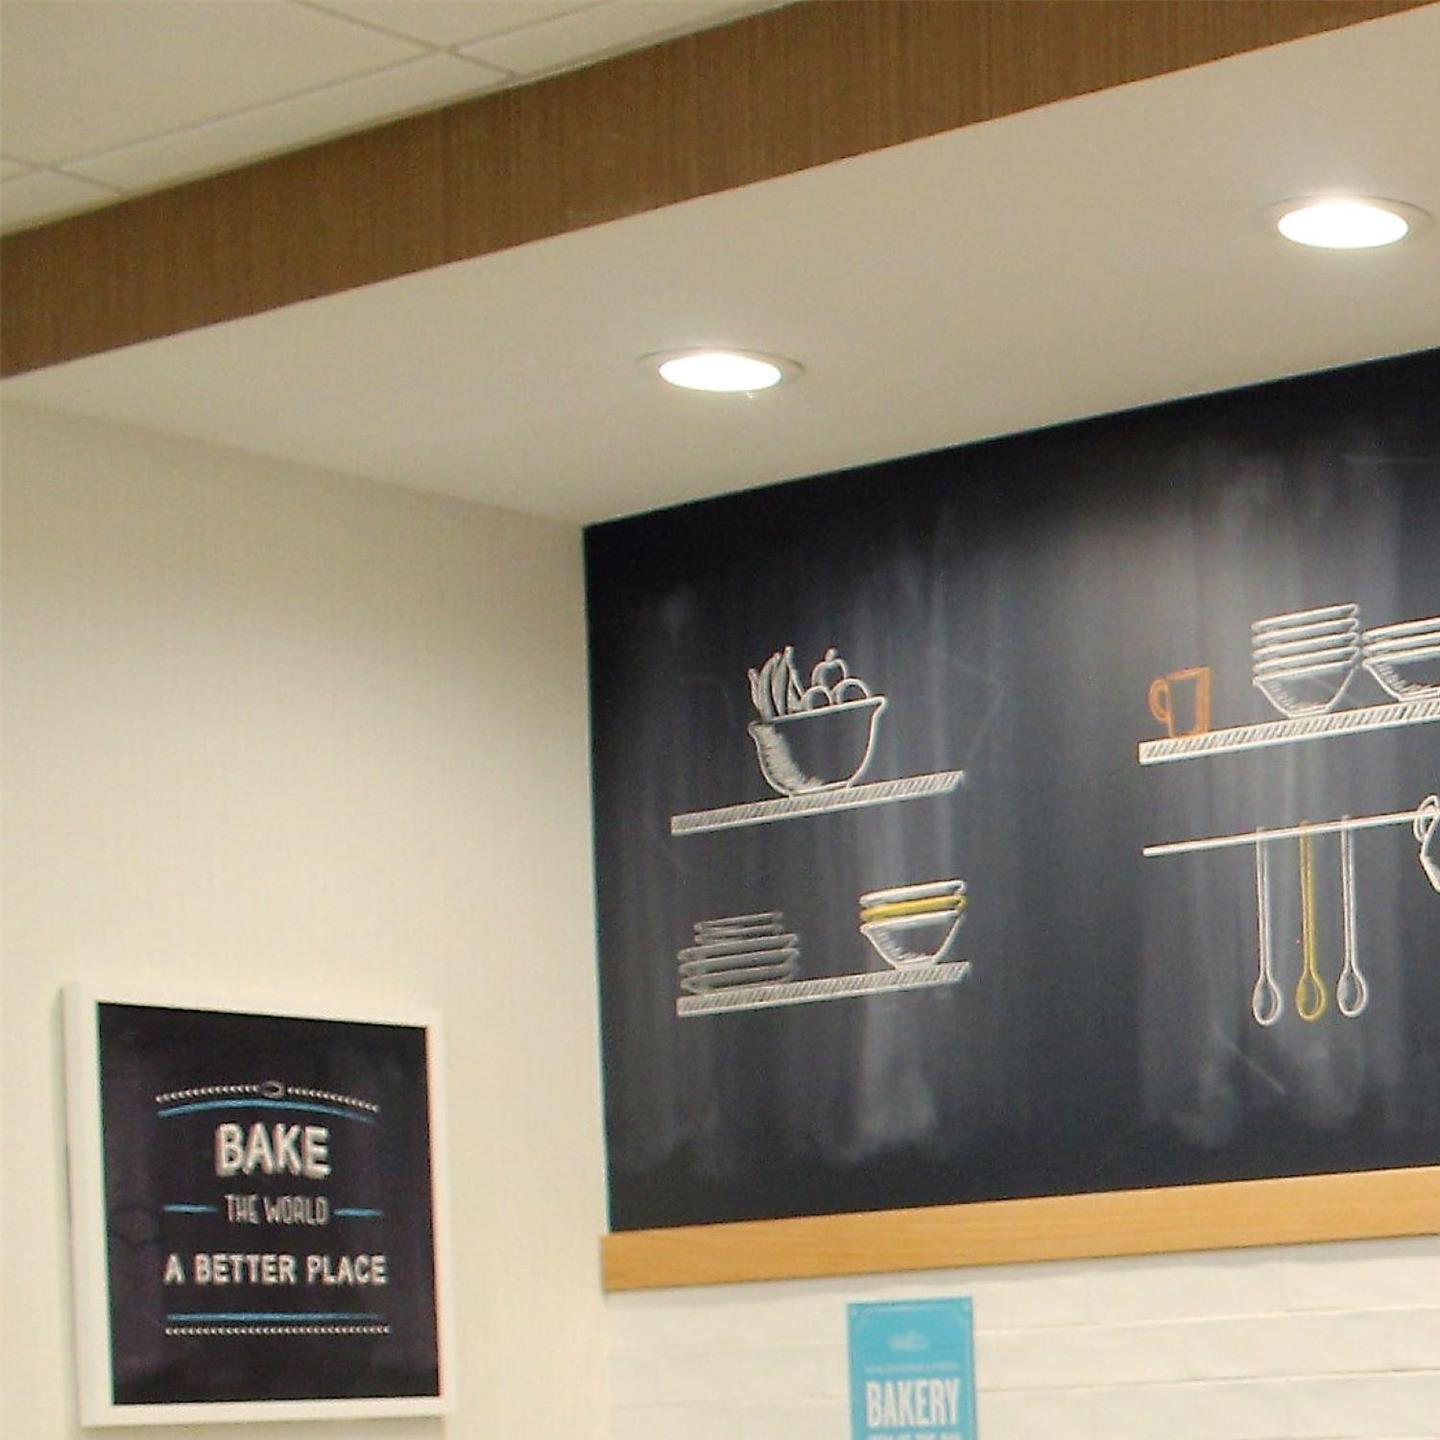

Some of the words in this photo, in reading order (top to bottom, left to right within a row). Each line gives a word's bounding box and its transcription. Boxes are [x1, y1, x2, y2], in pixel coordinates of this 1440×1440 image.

[215, 1121, 331, 1178] BAKE
[225, 1194, 259, 1225] THE
[265, 1196, 329, 1226] WORLD
[163, 1253, 185, 1285] A
[194, 1253, 297, 1285] BETTER
[307, 1254, 389, 1285] PLACE
[865, 1379, 960, 1429] BAKERY
